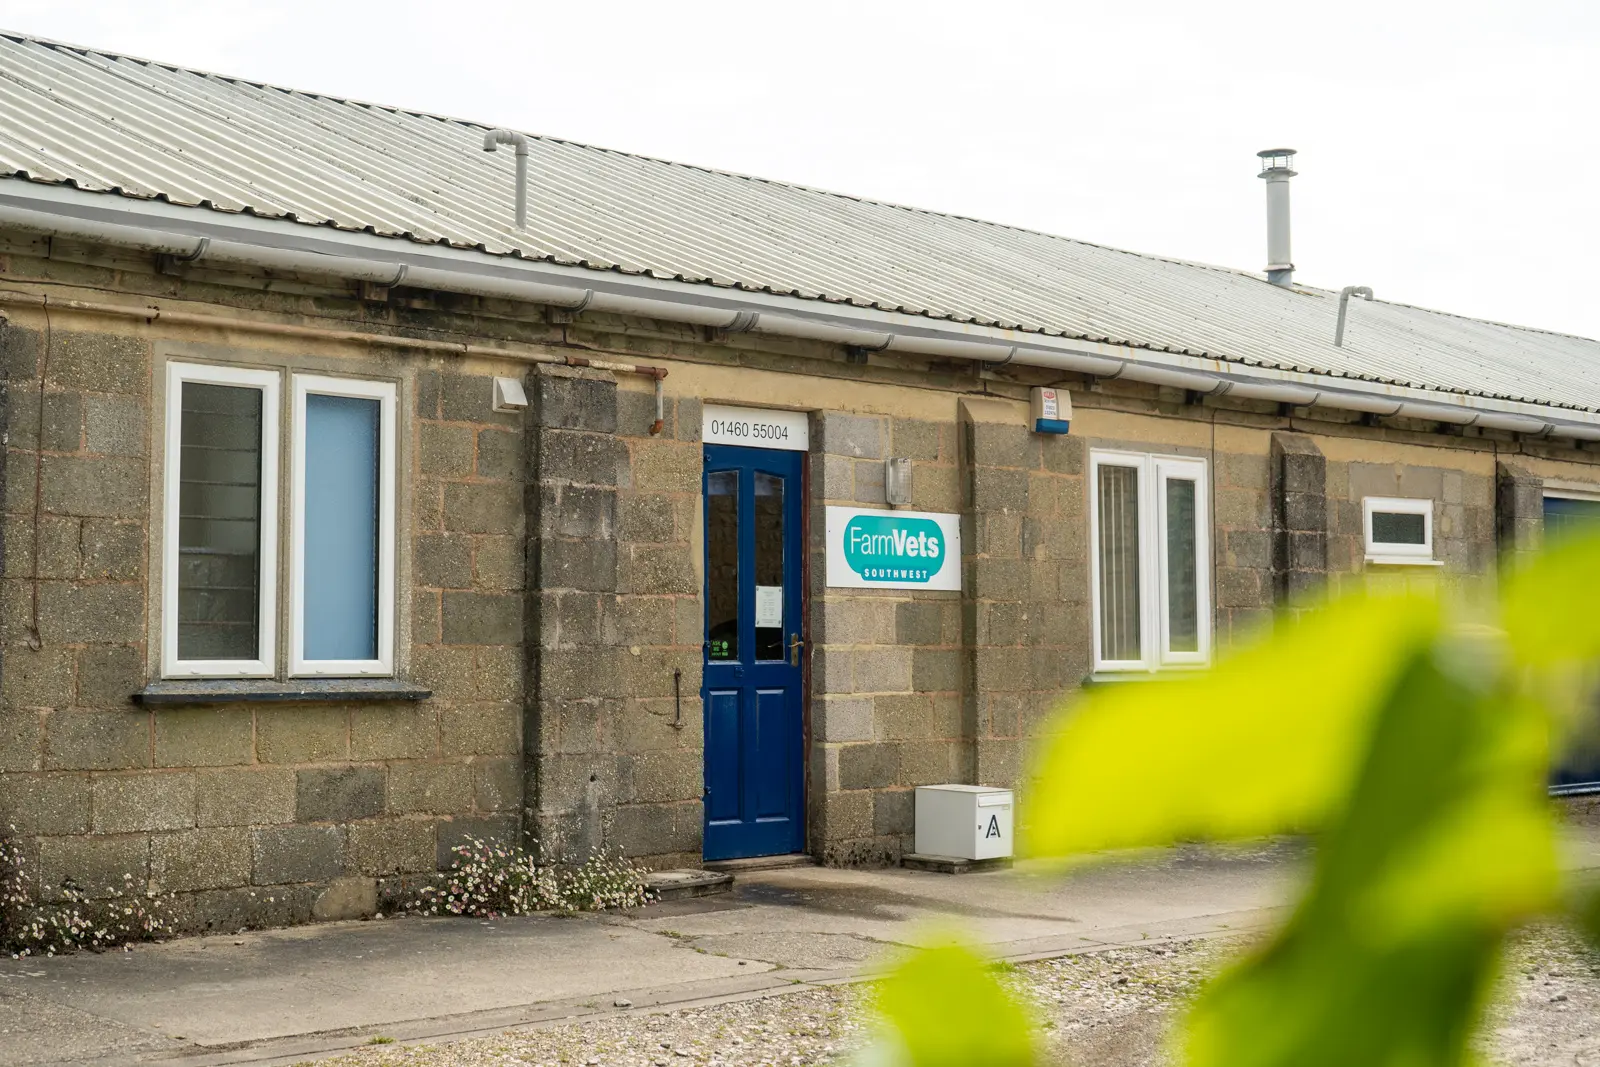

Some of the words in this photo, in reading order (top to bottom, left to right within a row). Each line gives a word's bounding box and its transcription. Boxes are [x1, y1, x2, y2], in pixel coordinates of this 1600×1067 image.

[711, 420, 749, 437] 01460
[752, 424, 788, 440] 55004
[850, 526, 940, 558] FarmVets
[864, 568, 928, 579] SOUTHWEST
